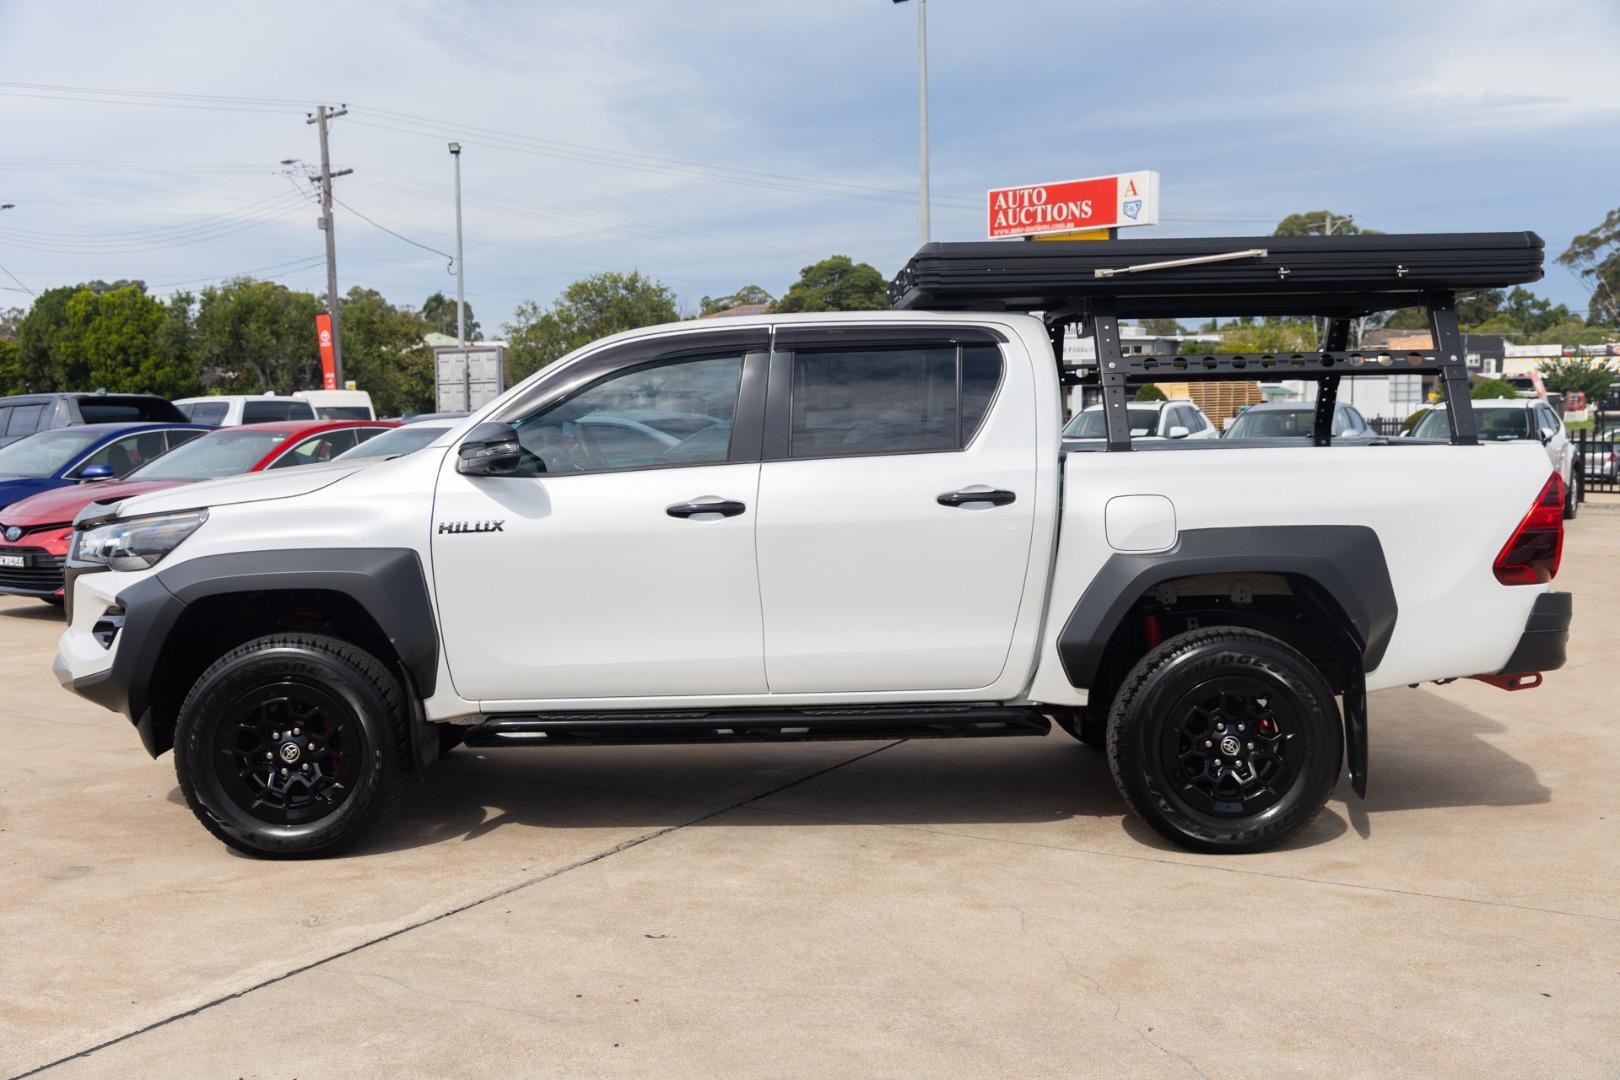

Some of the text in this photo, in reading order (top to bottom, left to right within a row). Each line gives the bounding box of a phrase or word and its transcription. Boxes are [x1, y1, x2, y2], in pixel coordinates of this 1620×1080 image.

[995, 188, 1046, 210] AUTO
[995, 201, 1092, 227] AUCTIONS
[994, 222, 1075, 236] www.auto-auctions.com.au
[438, 519, 505, 534] HILUX
[1183, 654, 1322, 713] BRIDGESTONE
